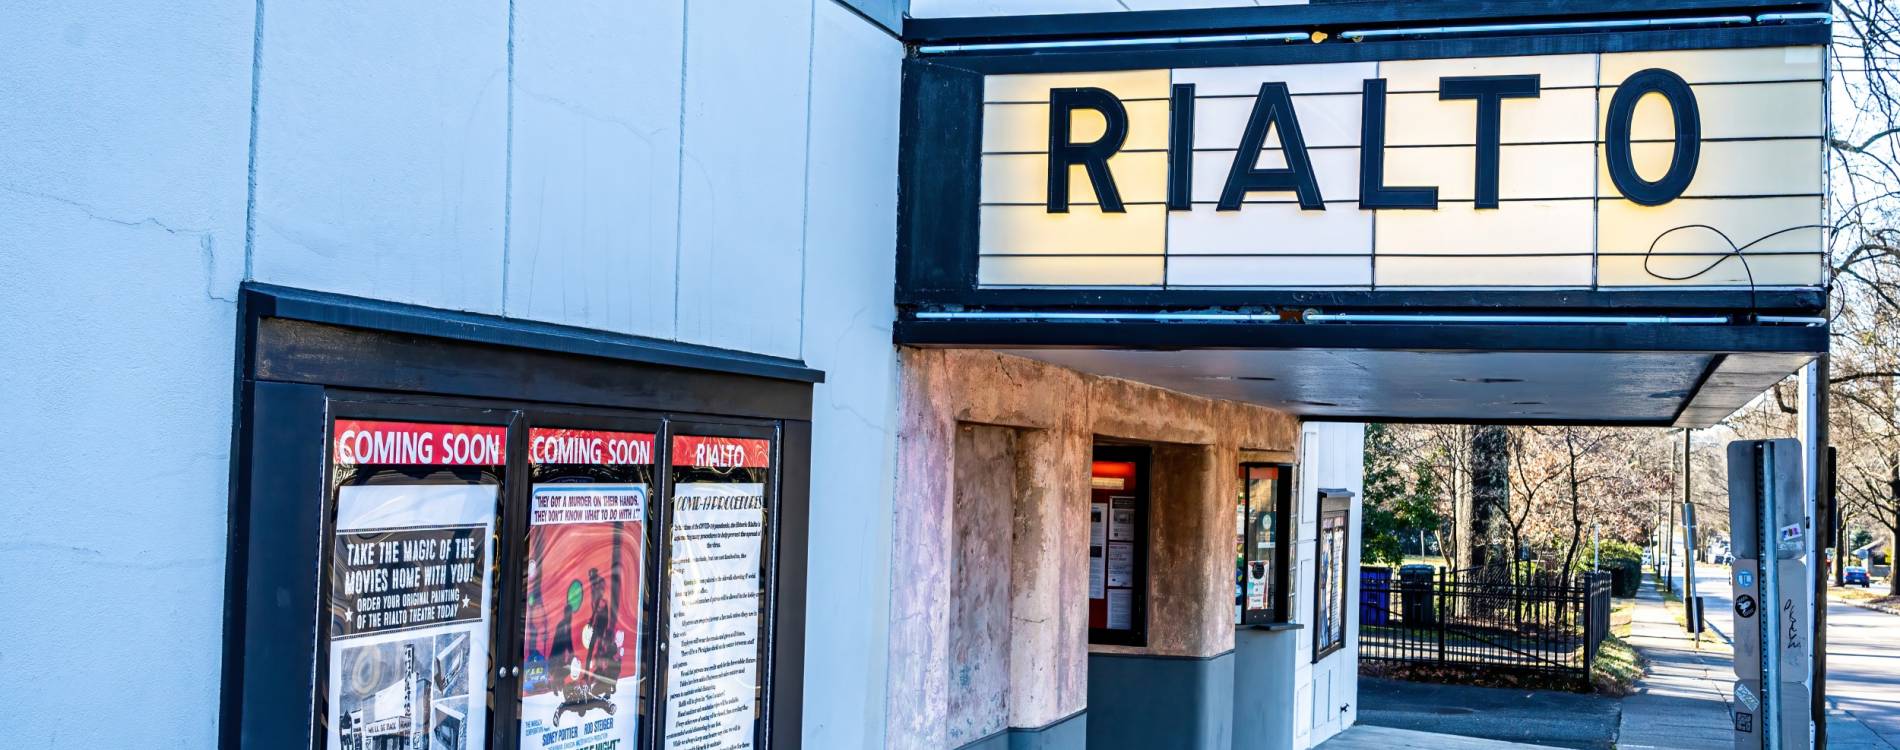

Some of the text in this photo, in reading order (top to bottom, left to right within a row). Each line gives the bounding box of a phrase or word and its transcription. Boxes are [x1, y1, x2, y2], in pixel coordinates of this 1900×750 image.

[1047, 68, 1702, 213] RIALTO
[339, 429, 500, 465] COMING SOON
[531, 436, 650, 465] COMING SOON
[696, 443, 744, 467] RIALTO
[550, 495, 562, 508] GOT
[562, 496, 567, 507] A
[568, 495, 592, 507] MURDER
[593, 495, 602, 507] ON
[602, 495, 618, 507] THEIR
[534, 510, 547, 522] THEY
[565, 509, 583, 521] KNOW
[584, 509, 600, 520] WHAT
[601, 509, 608, 520] TO
[609, 509, 618, 520] DO
[619, 509, 632, 520] WITH
[347, 538, 475, 566] TAKE THE MAGIC OF THE
[344, 563, 475, 595] MOVIES HOME WITH YOU!
[357, 588, 460, 612] ORDER YOUR ORIGINAL PAINTING
[357, 603, 459, 629] OF THE RIALTO THEATRE TODAY
[542, 730, 559, 746] SIDNEY
[558, 726, 579, 741] POITIER
[584, 717, 614, 735] ROD STEIGER
